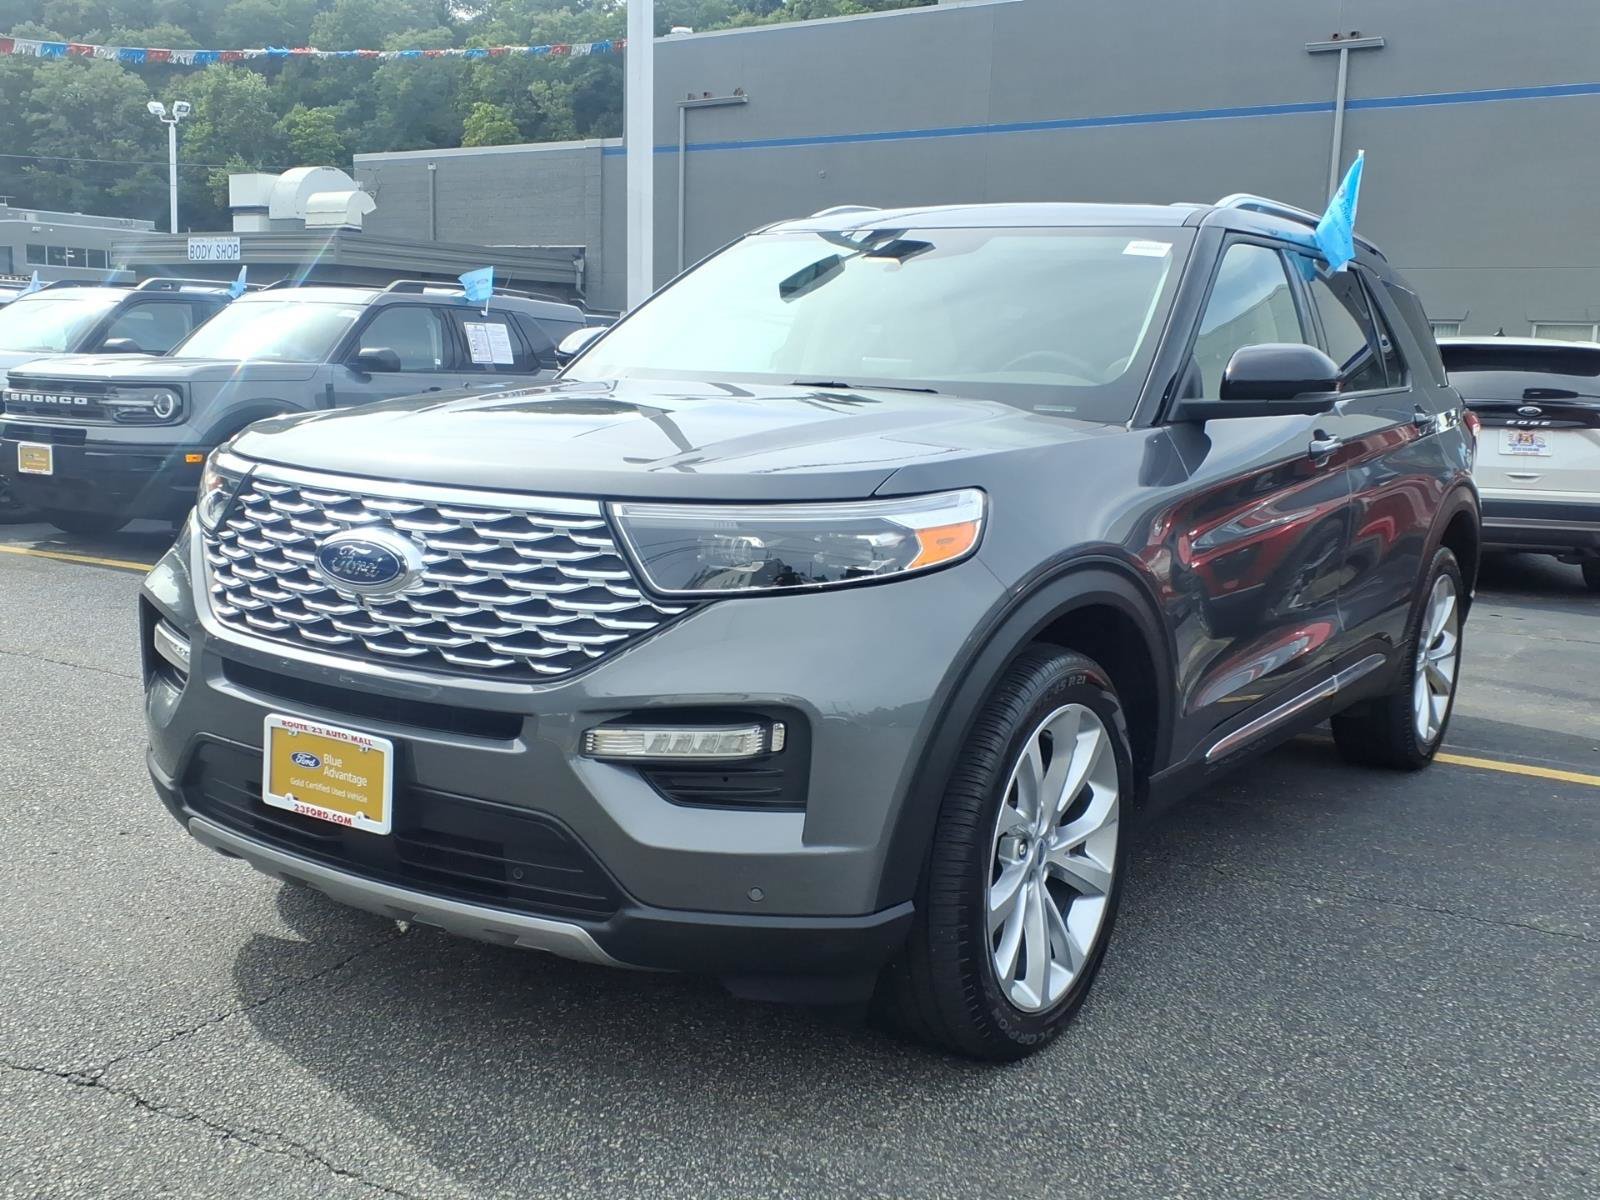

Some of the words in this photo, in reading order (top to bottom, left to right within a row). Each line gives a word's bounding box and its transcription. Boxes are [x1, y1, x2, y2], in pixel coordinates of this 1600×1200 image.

[190, 244, 212, 259] BODY
[215, 243, 239, 259] SHOP
[10, 393, 88, 405] BRONCO
[281, 720, 308, 731] ROUTE
[311, 726, 323, 735] 23
[325, 729, 348, 741] AUTO
[351, 735, 373, 746] MALL
[295, 752, 317, 768] Ford
[323, 753, 343, 768] Blue
[323, 766, 368, 787] Advantage
[290, 777, 304, 788] Gold
[305, 780, 331, 794] Certified
[330, 786, 346, 798] Used
[346, 790, 368, 804] Vehicle
[293, 803, 353, 826] 23FORD.COM
